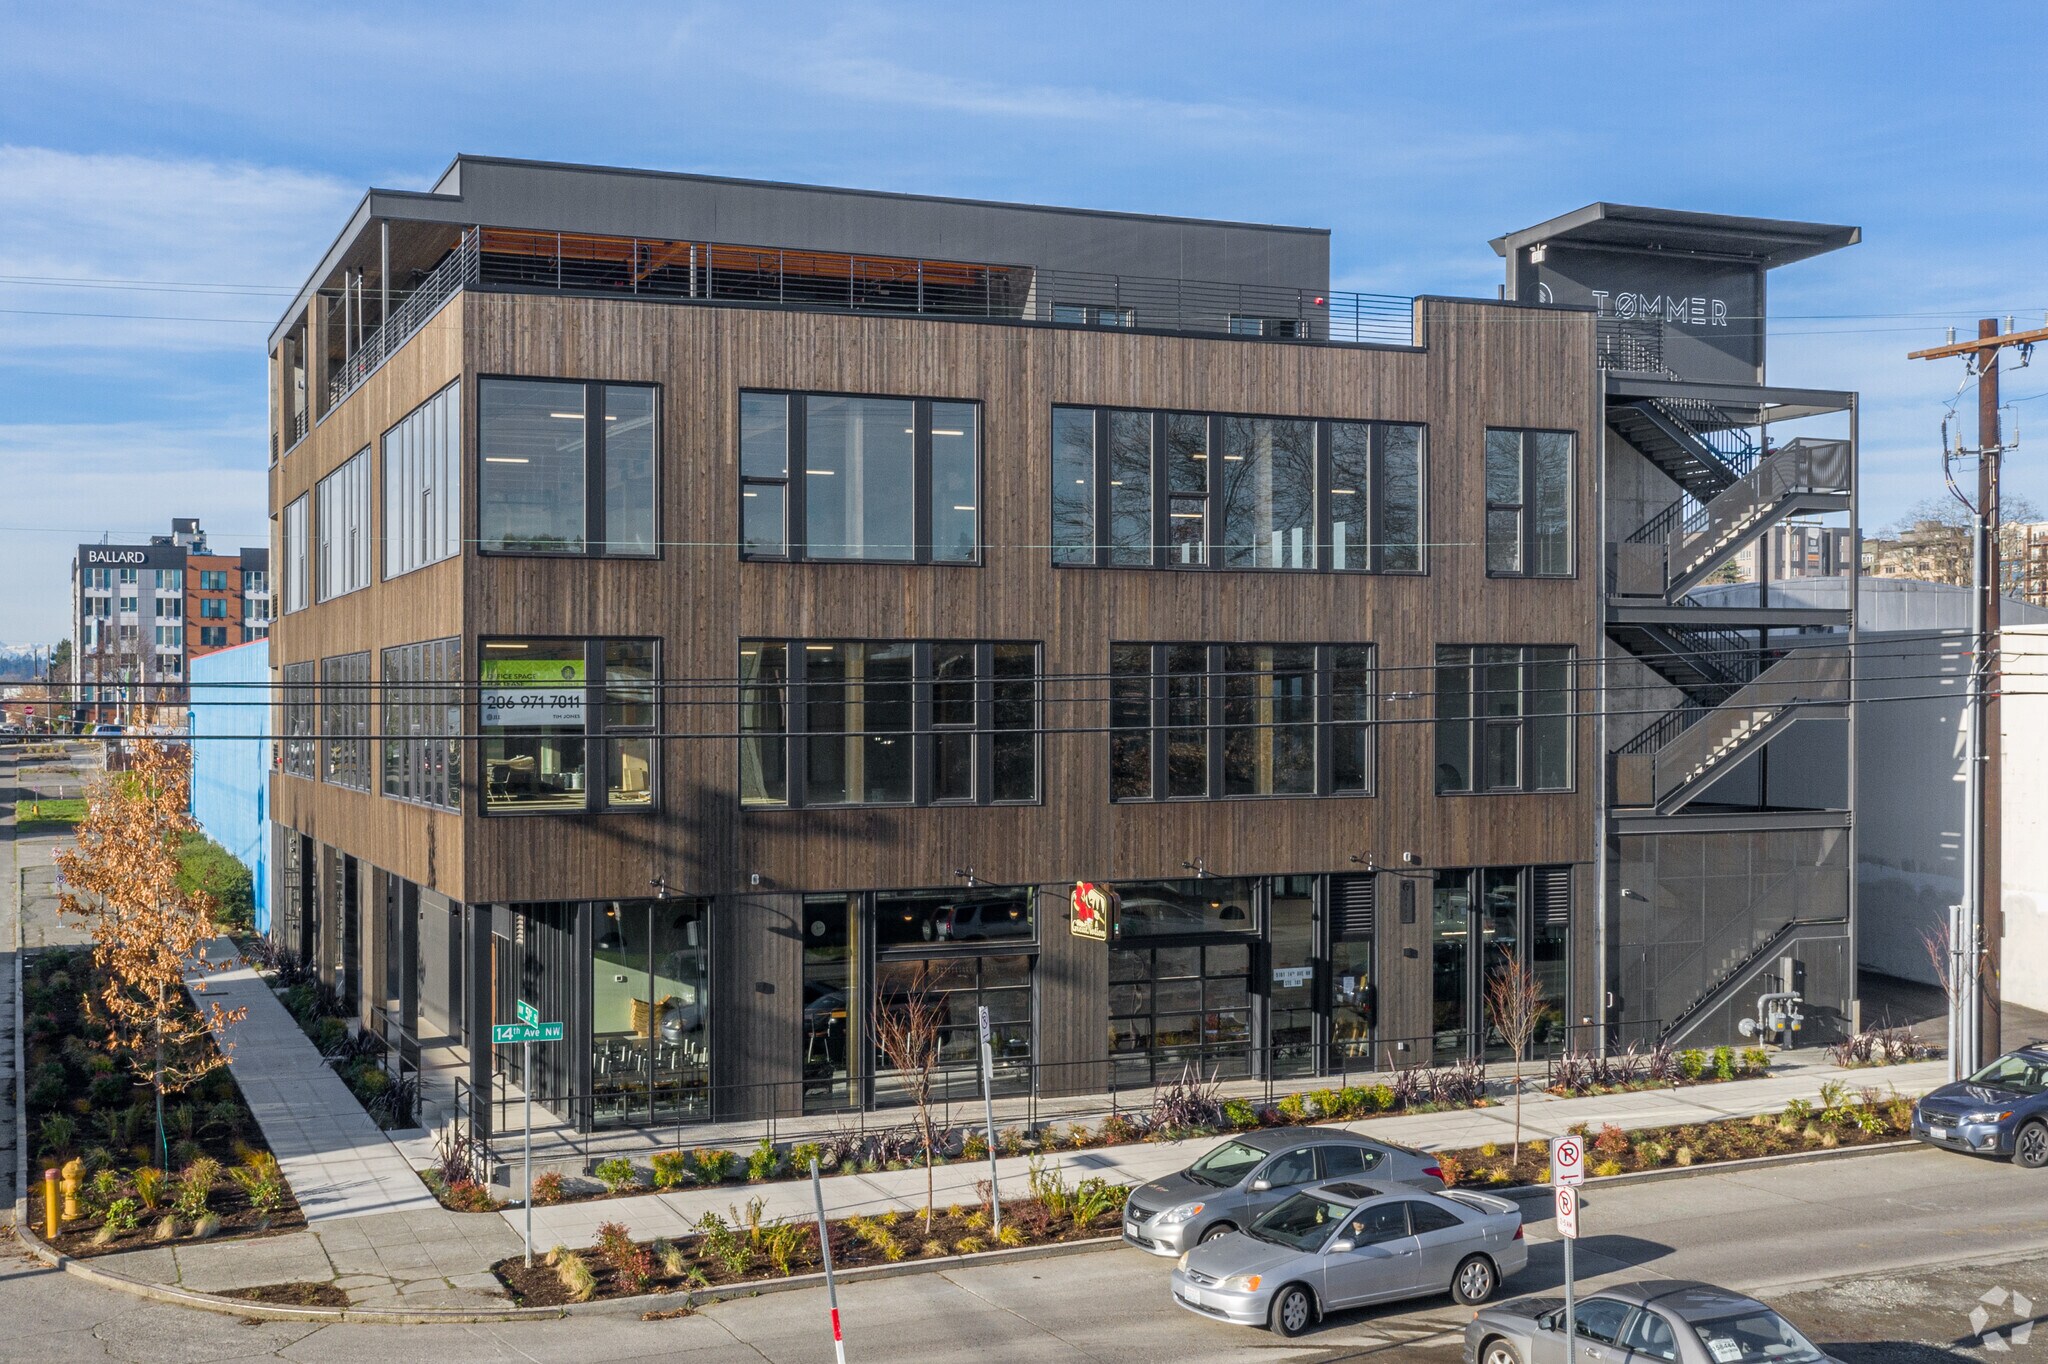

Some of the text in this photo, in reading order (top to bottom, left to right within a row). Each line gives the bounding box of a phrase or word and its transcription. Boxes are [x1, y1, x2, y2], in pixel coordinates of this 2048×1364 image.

[89, 550, 145, 563] BALLARD
[487, 695, 580, 710] 206 971 7011
[496, 1026, 560, 1040] 14th Ave NW
